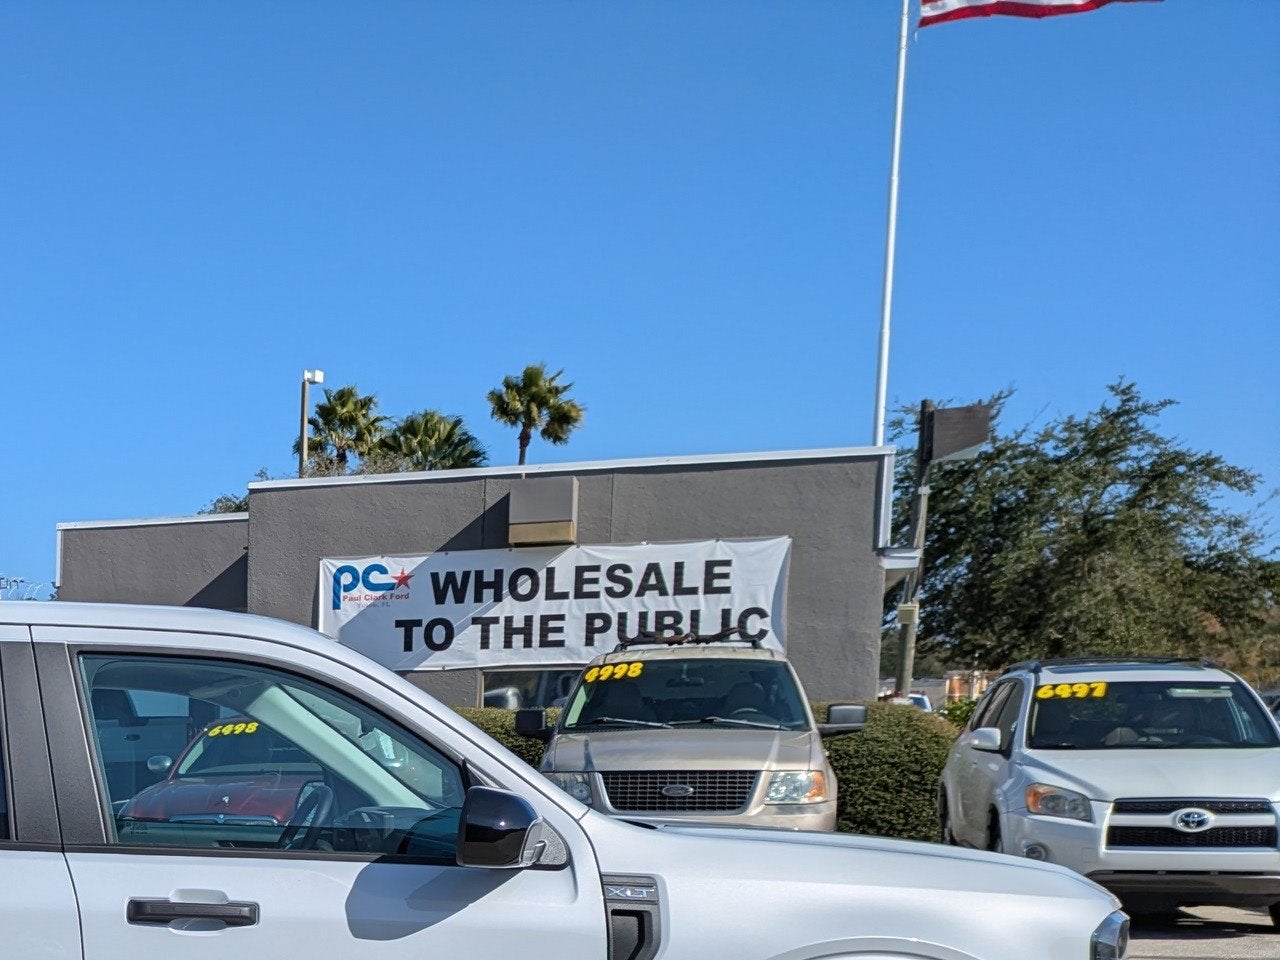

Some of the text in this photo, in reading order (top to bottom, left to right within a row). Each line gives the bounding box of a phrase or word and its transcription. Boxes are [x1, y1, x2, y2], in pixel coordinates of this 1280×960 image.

[430, 559, 733, 605] WHOLESALE
[364, 593, 387, 601] Clark
[395, 607, 770, 652] TO THE PUBLIC
[608, 885, 656, 898] XLT
